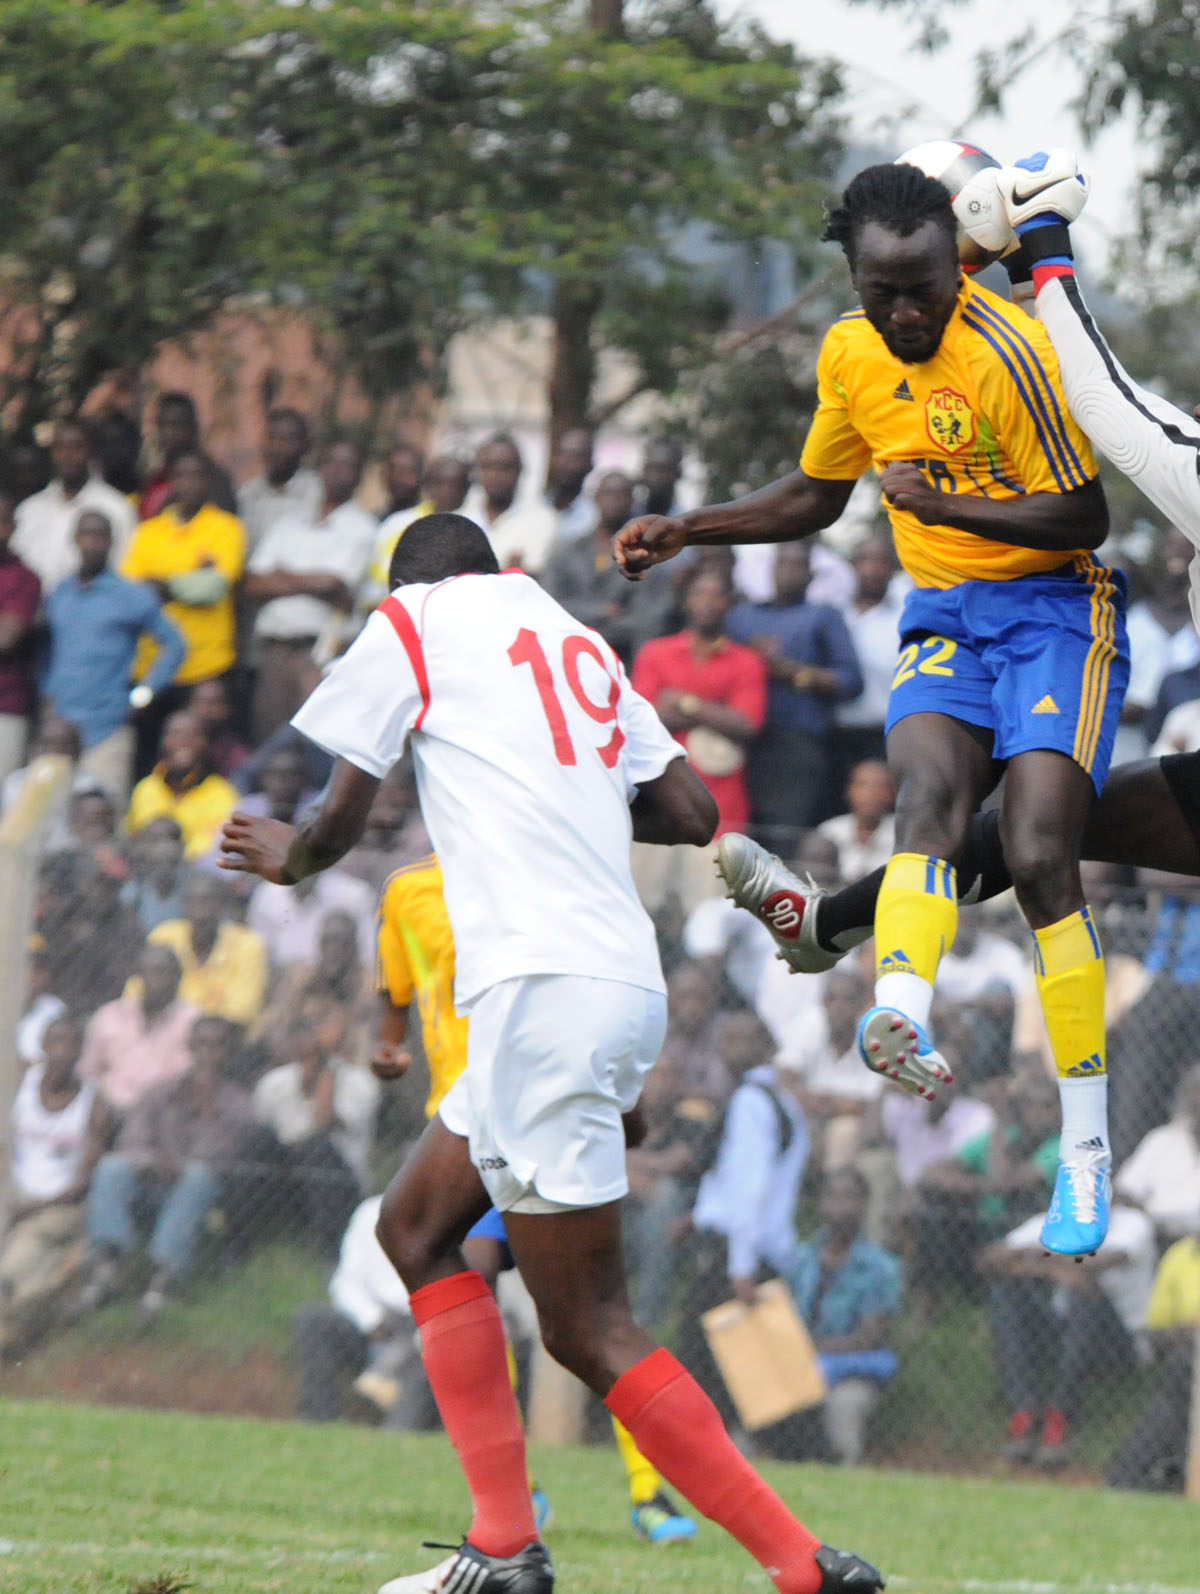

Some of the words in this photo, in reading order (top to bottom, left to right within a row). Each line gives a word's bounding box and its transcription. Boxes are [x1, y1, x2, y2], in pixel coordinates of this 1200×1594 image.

[935, 393, 963, 411] KCC
[891, 635, 957, 691] 22
[506, 627, 627, 769] 19
[767, 898, 800, 930] 90
